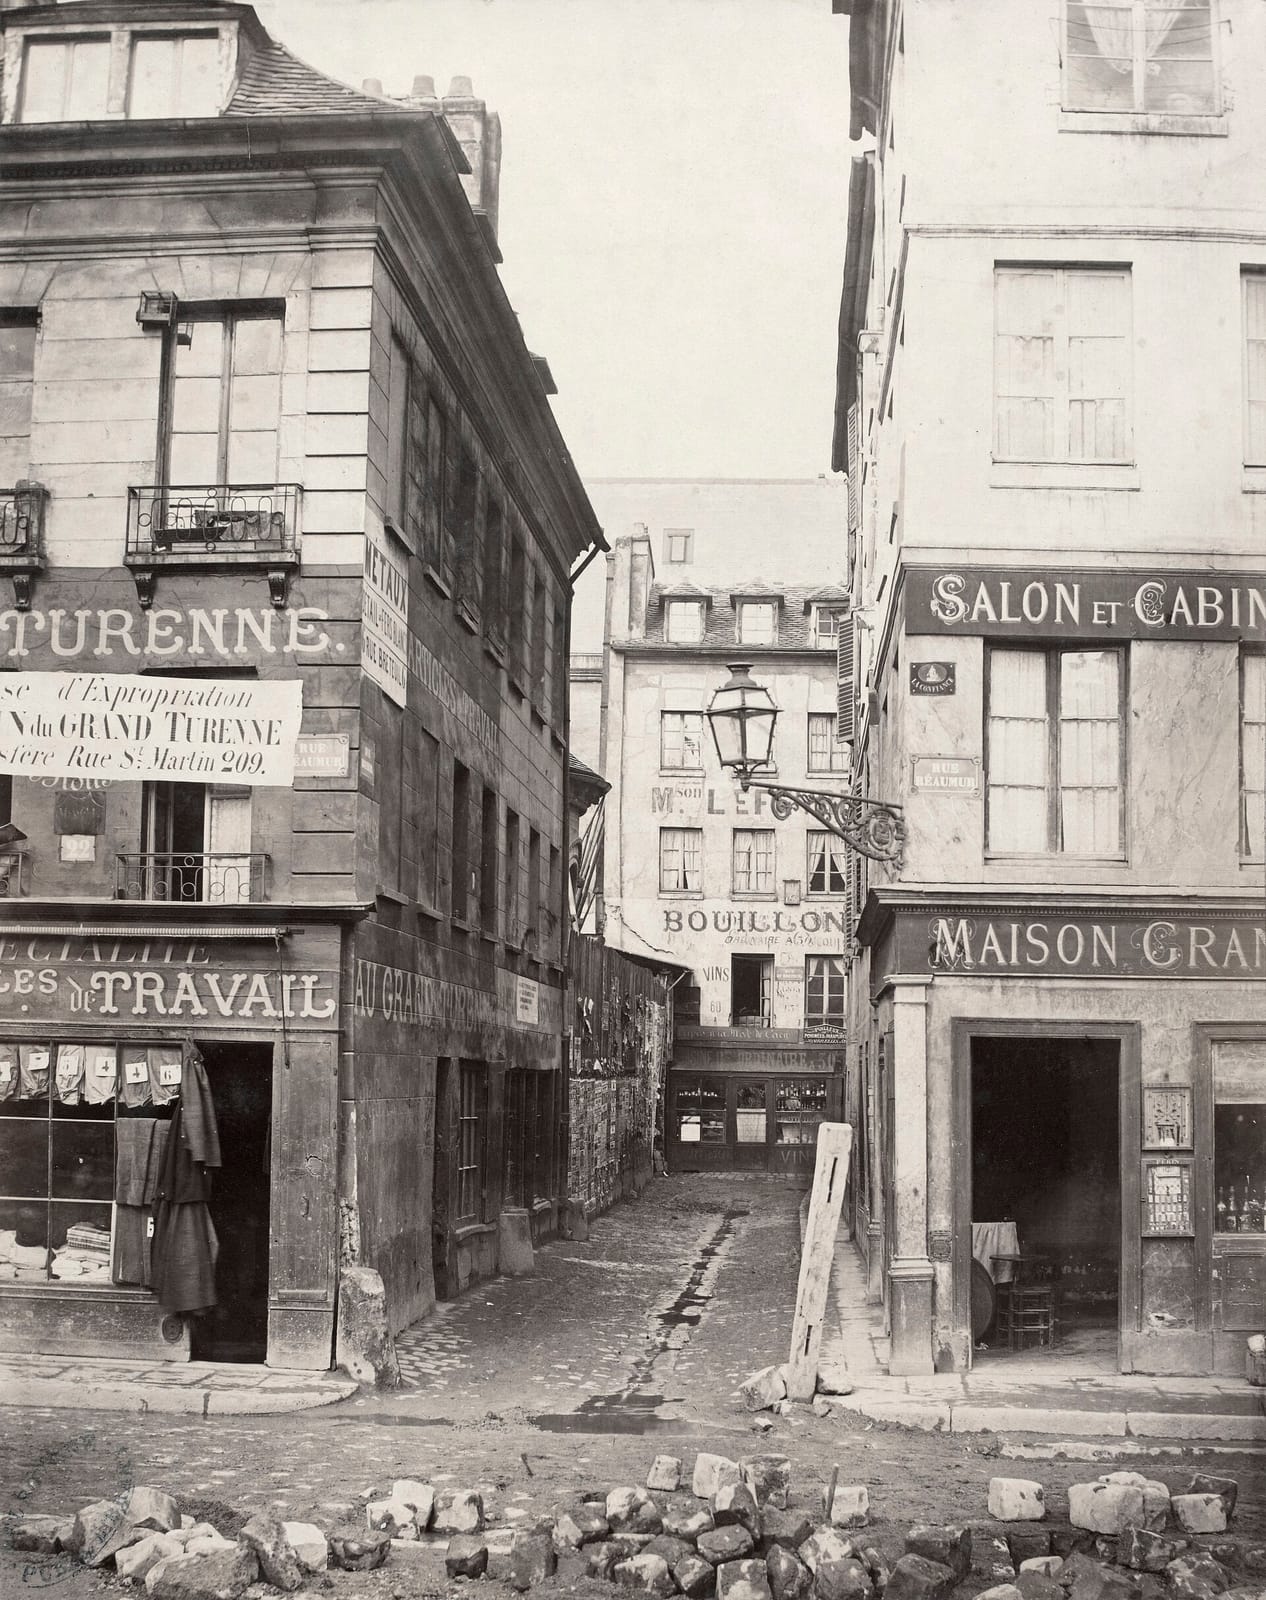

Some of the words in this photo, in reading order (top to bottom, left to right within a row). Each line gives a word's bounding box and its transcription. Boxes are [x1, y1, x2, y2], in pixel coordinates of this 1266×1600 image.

[930, 574, 1081, 626] SALON
[1092, 601, 1123, 625] ET
[0, 607, 345, 657] TURENNE.
[31, 714, 51, 737] du
[59, 713, 152, 740] GRAND
[165, 711, 282, 745] TURENNE
[67, 745, 112, 769] Rue
[147, 746, 215, 772] Martin
[300, 743, 327, 753] RUE
[931, 762, 959, 774] RUE
[663, 910, 845, 933] BOUILLON
[928, 917, 1117, 969] MAISON
[703, 966, 730, 982] VINS
[90, 971, 336, 1018] TRAVAIL
[354, 959, 377, 1018] AU
[382, 965, 434, 1028] GRAND
